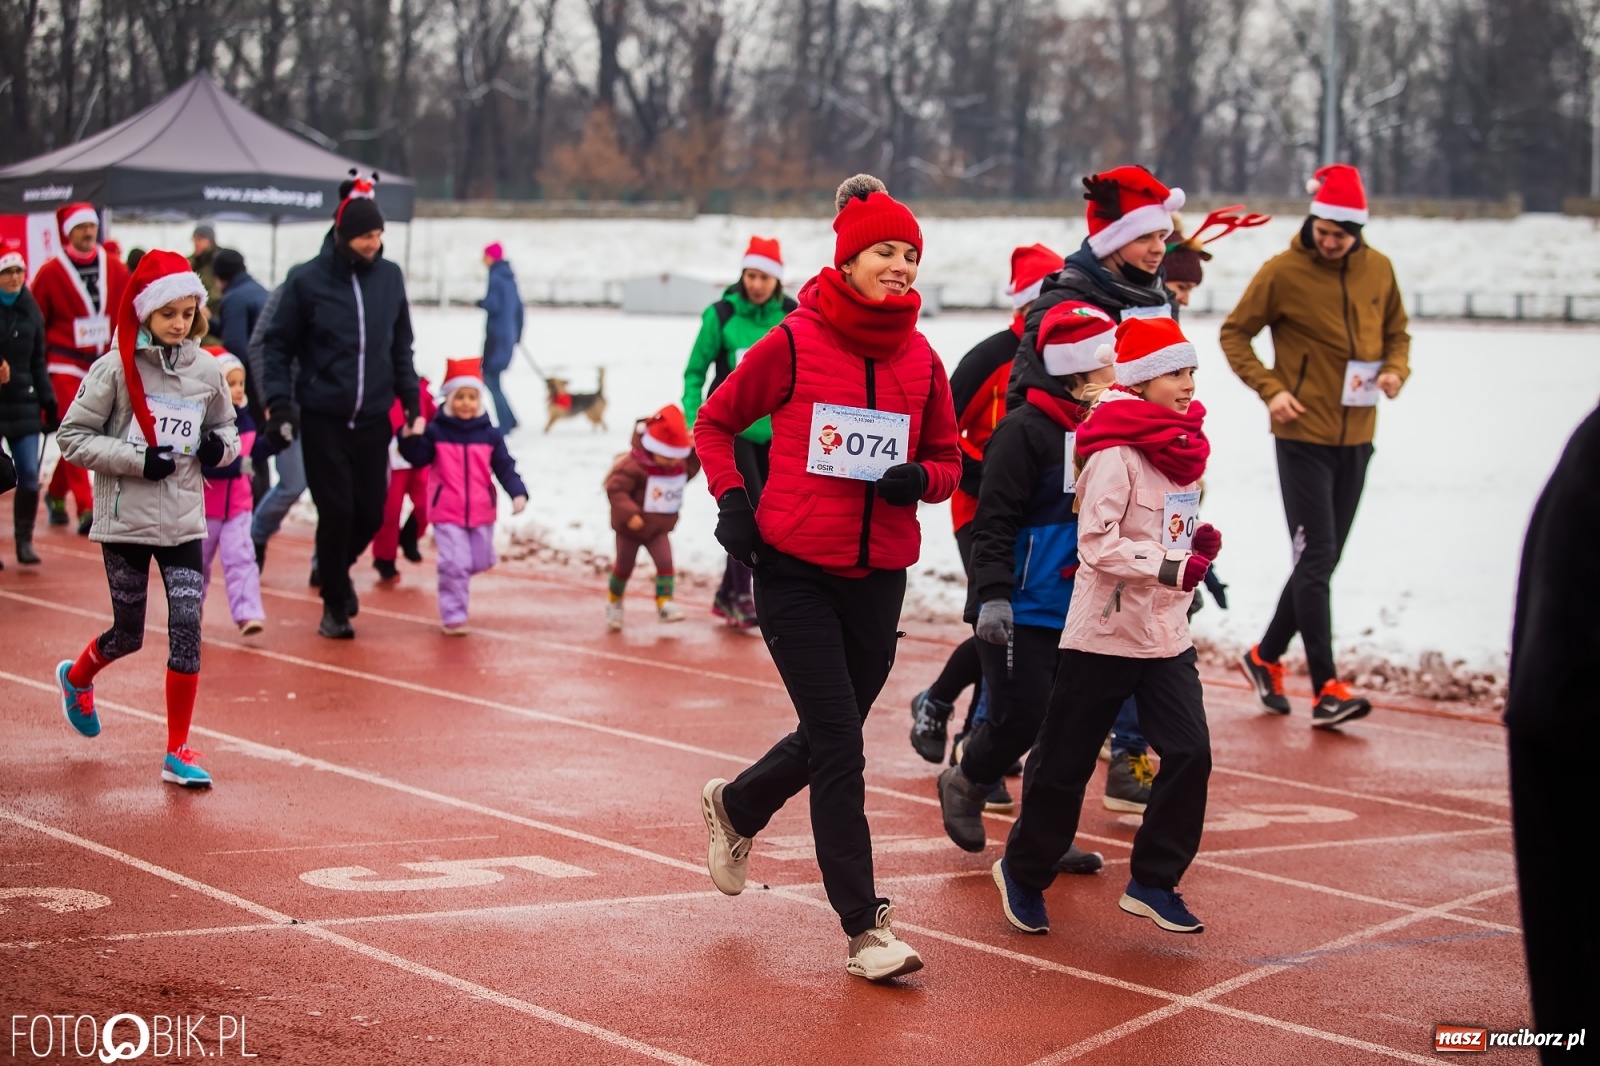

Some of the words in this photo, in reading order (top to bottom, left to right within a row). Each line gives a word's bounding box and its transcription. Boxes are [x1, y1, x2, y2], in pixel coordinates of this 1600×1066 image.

[160, 416, 192, 437] 178
[846, 432, 899, 461] 074
[299, 855, 599, 887] 5
